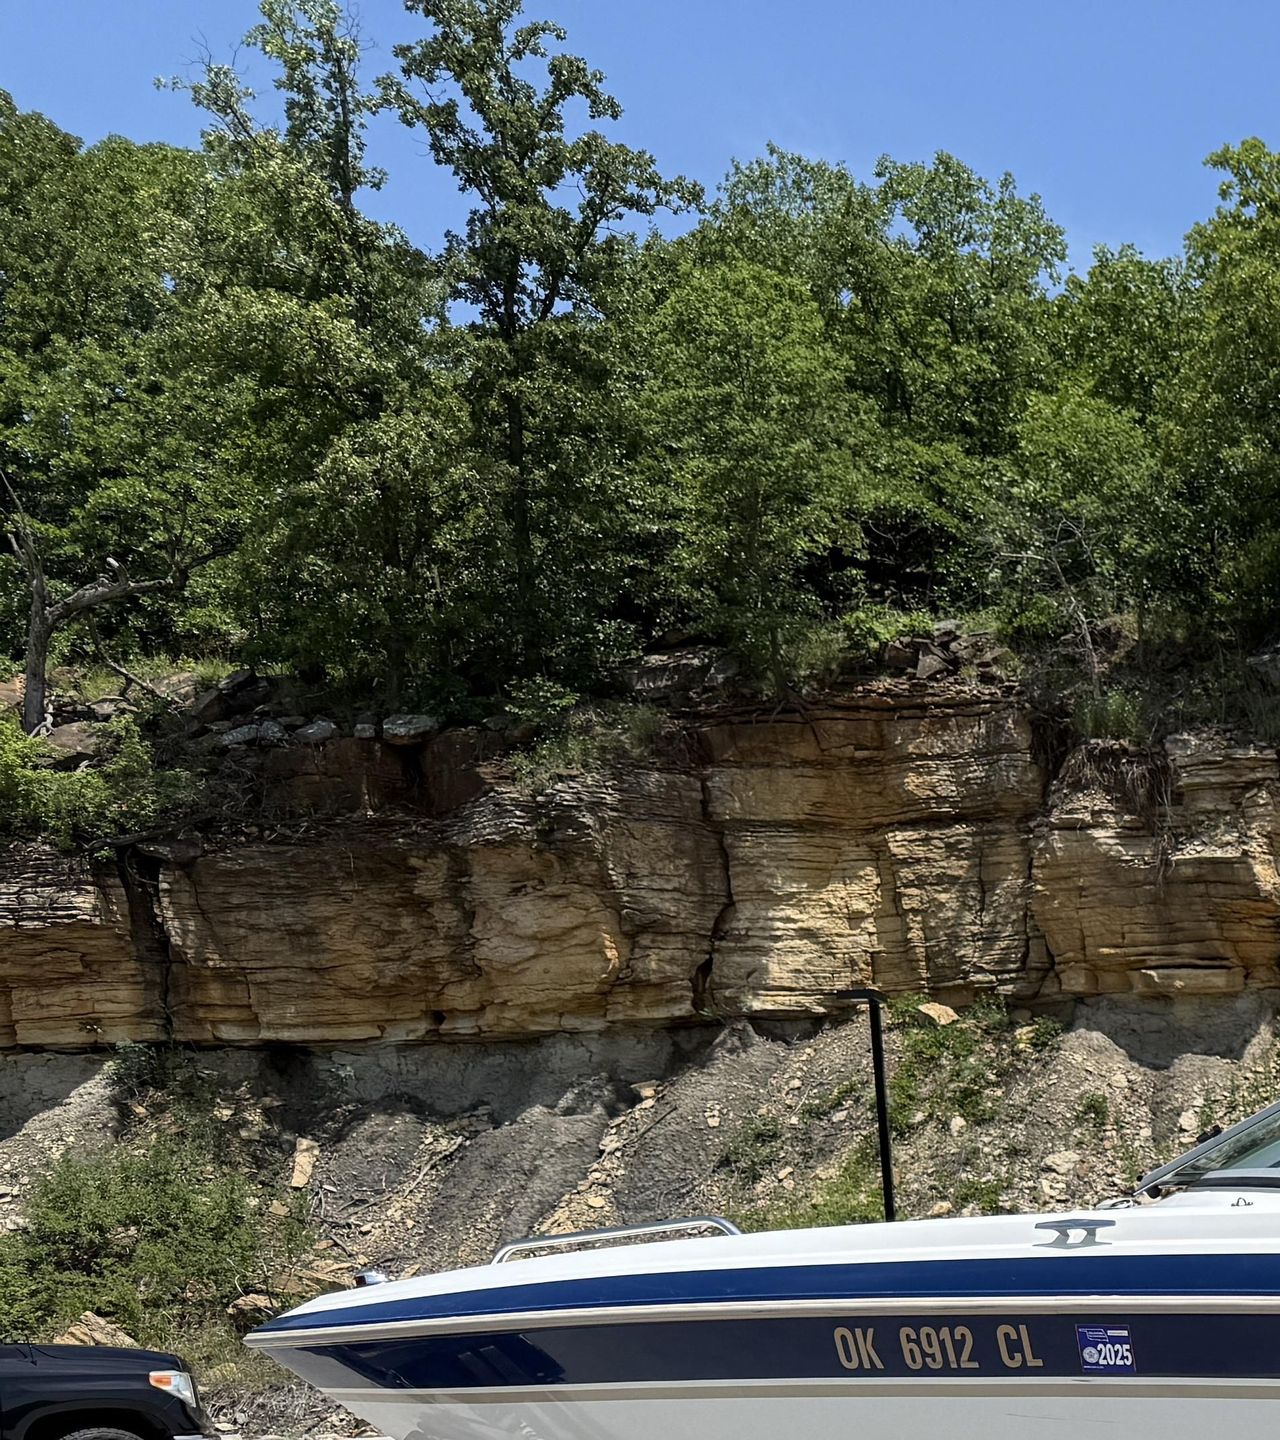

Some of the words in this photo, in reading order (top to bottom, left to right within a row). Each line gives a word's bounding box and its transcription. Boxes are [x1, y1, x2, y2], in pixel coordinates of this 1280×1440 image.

[833, 1326, 885, 1369] OK
[899, 1325, 980, 1369] 6912
[996, 1324, 1044, 1367] CL
[1097, 1343, 1133, 1366] 2025
